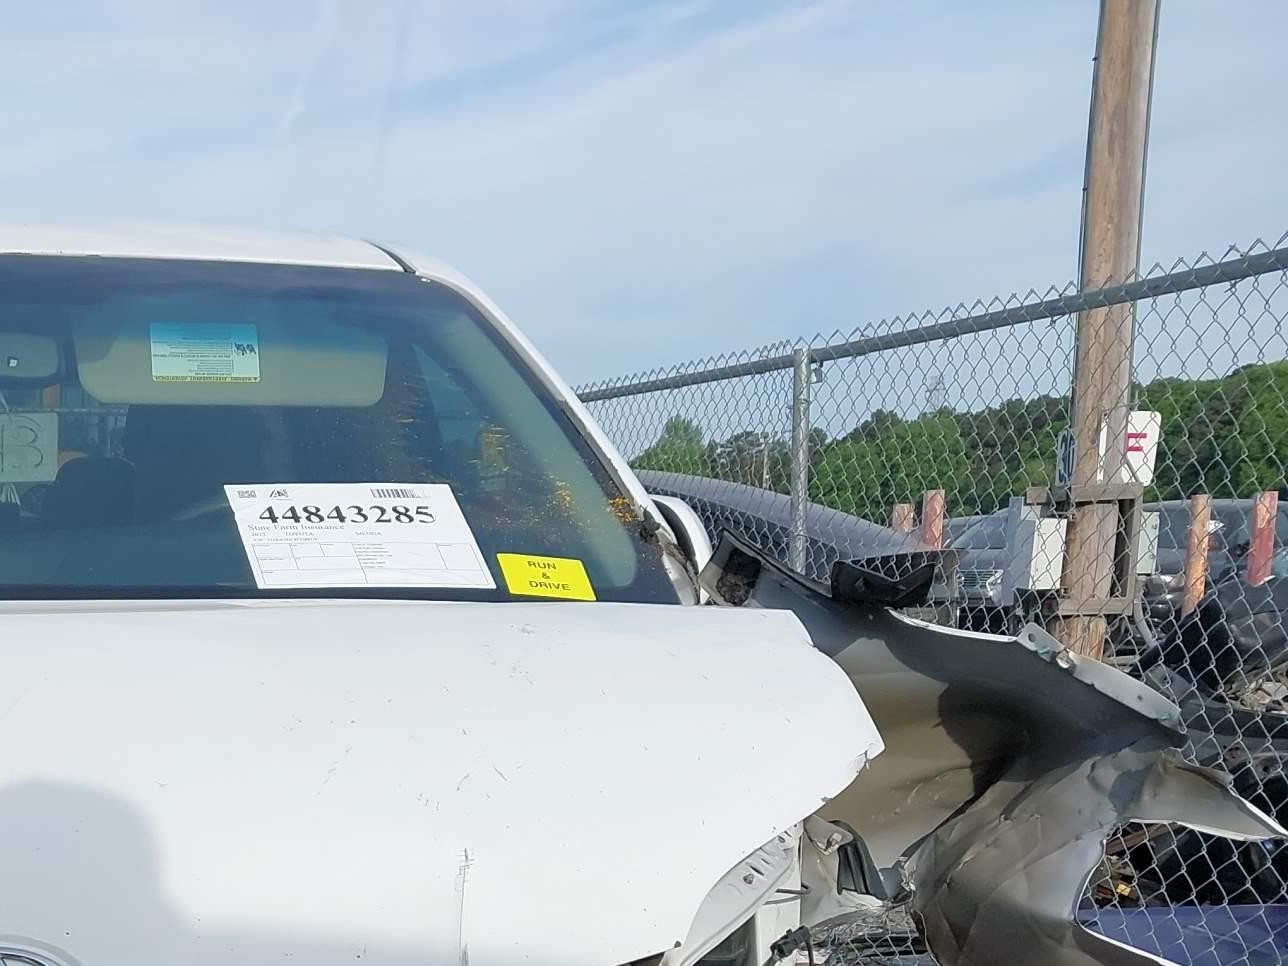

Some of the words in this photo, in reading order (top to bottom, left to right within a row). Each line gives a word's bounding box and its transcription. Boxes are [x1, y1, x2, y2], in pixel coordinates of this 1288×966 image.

[259, 505, 436, 524] 44843285
[527, 560, 557, 570] RUN
[541, 572, 551, 580] &
[529, 580, 572, 591] DRIVE
